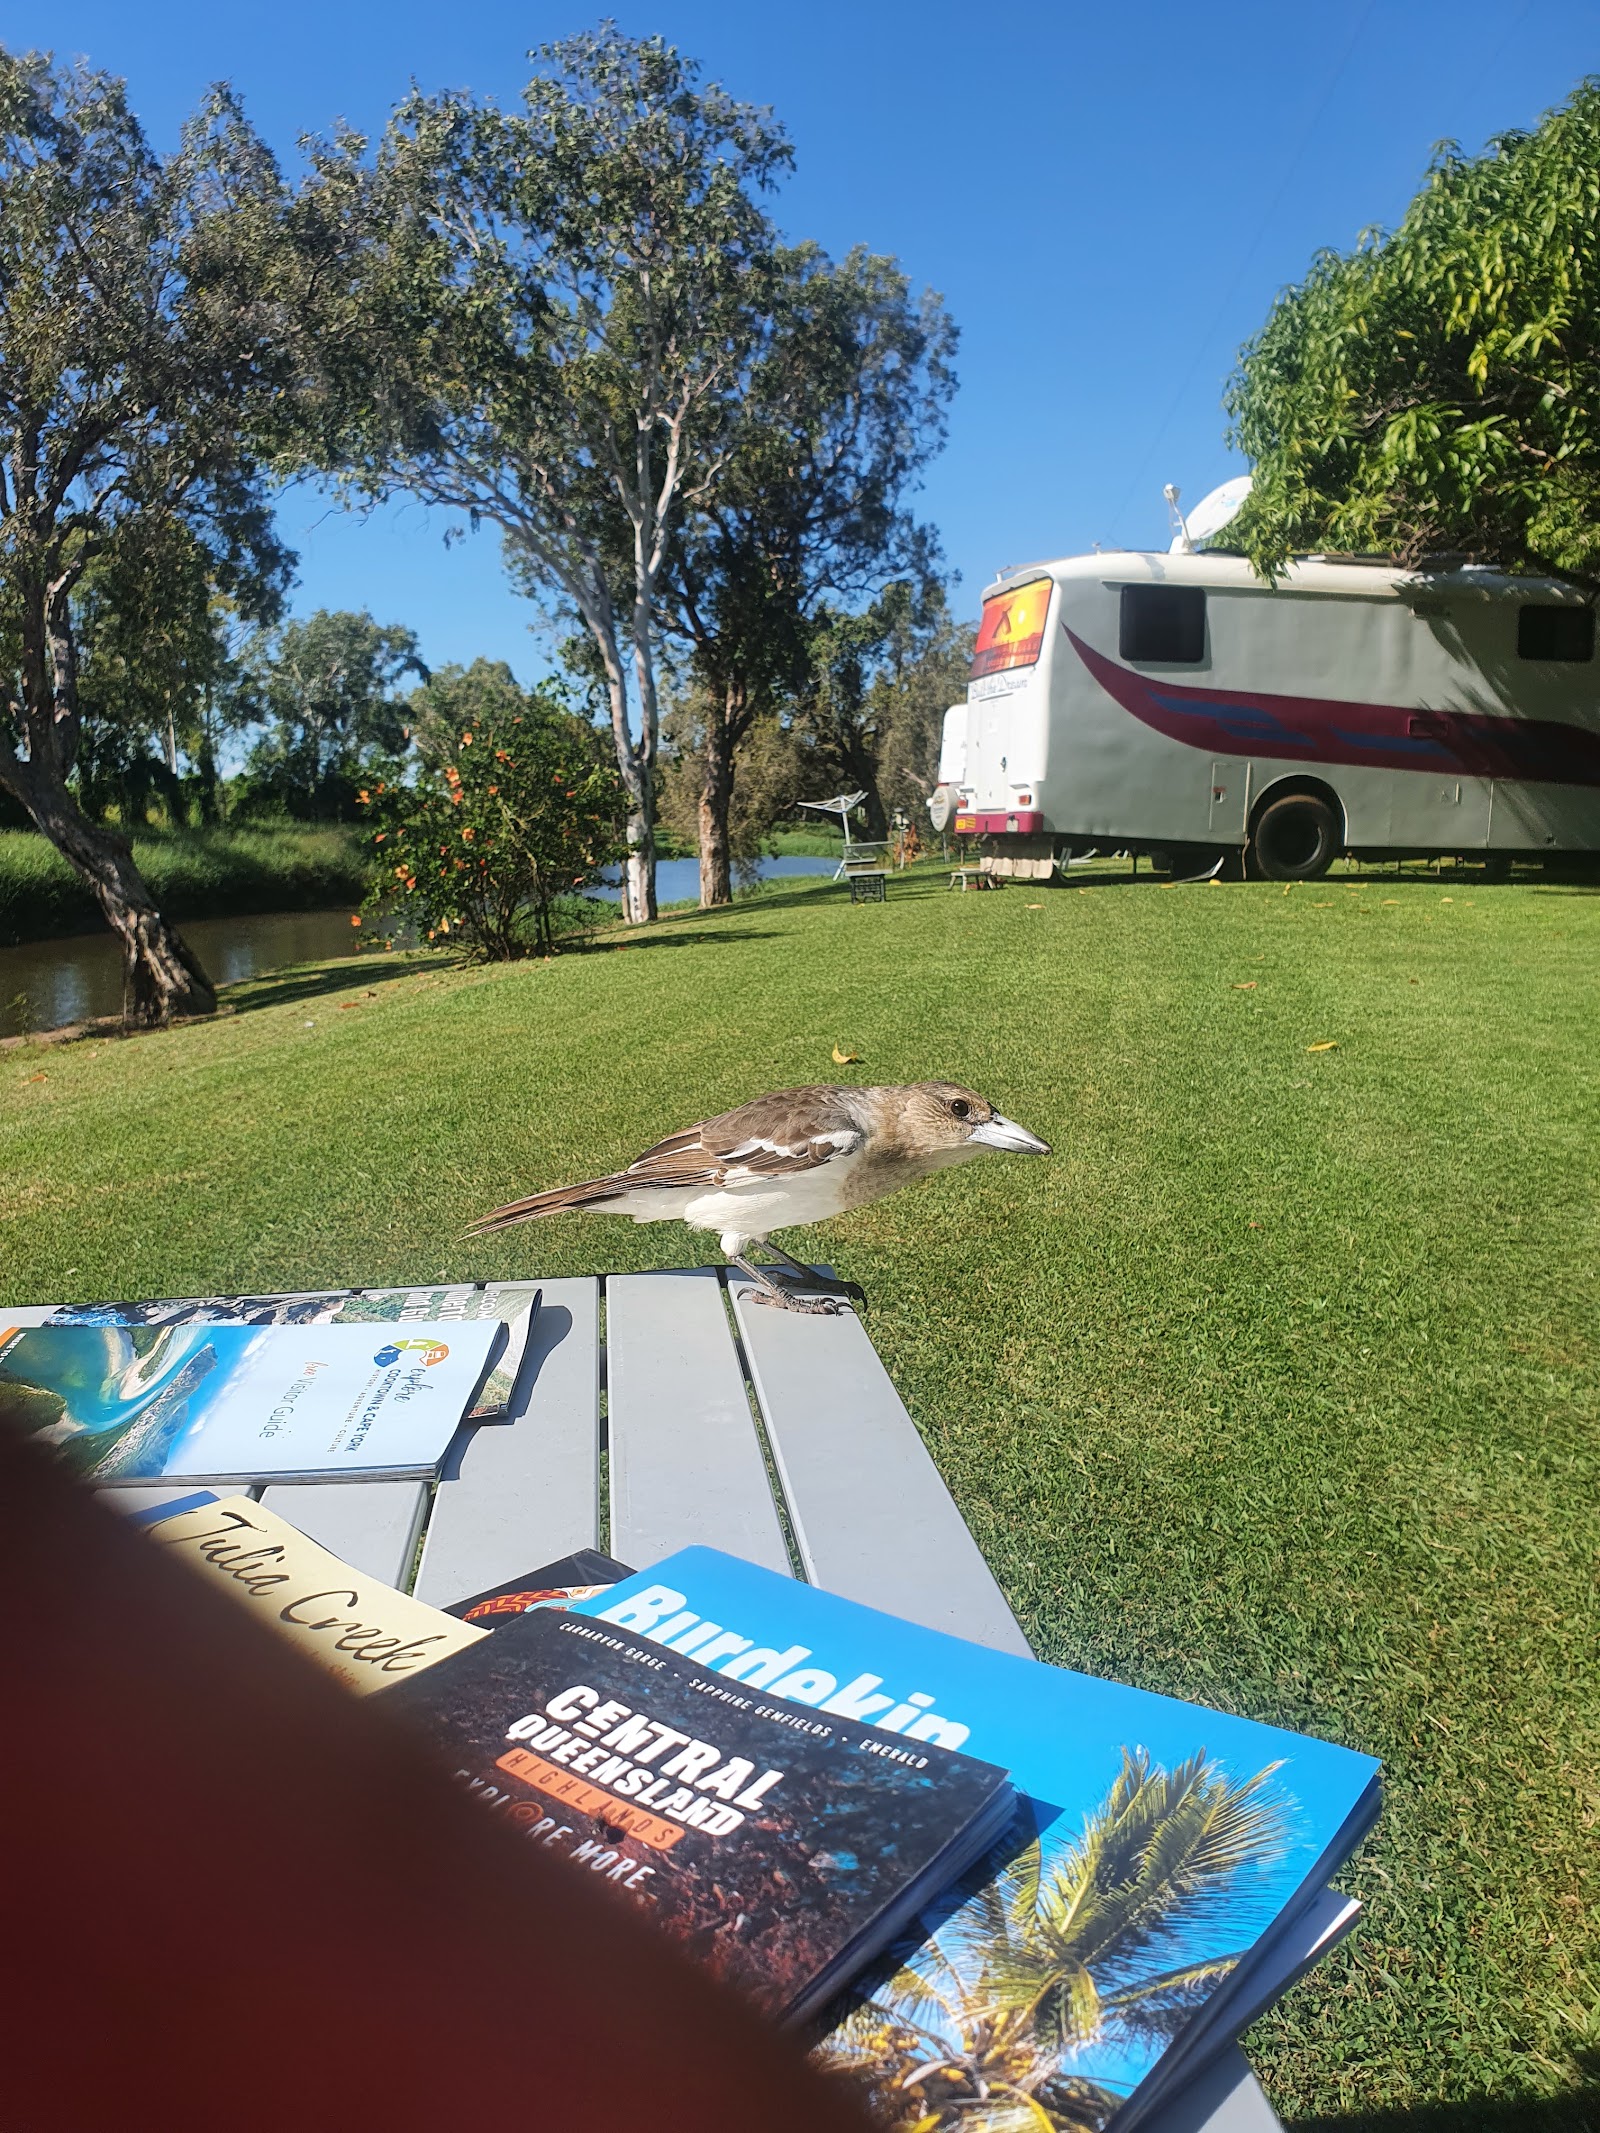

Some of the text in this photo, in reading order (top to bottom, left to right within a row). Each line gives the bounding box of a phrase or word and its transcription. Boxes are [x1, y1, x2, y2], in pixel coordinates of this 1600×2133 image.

[281, 1377, 317, 1403] Visitor
[345, 1392, 366, 1422] ADVENTURE
[370, 1369, 401, 1405] COOKTOWN
[259, 1407, 294, 1437] Guide
[327, 1430, 346, 1452] CULTURE
[344, 1433, 367, 1451] YORK
[356, 1413, 376, 1431] CAPE
[279, 1590, 447, 1672] Creek
[596, 1584, 970, 1755] Burdekin
[558, 1622, 626, 1650] CARNARVON
[625, 1647, 667, 1671] GORGE
[688, 1678, 754, 1710] SAPPHIRE
[859, 1738, 929, 1769] EMERALD
[545, 1685, 786, 1811] CENTRAL
[505, 1714, 746, 1836] QUEENSLAND
[506, 1753, 674, 1843] HIGHLANDS
[568, 1839, 656, 1889] MORE
